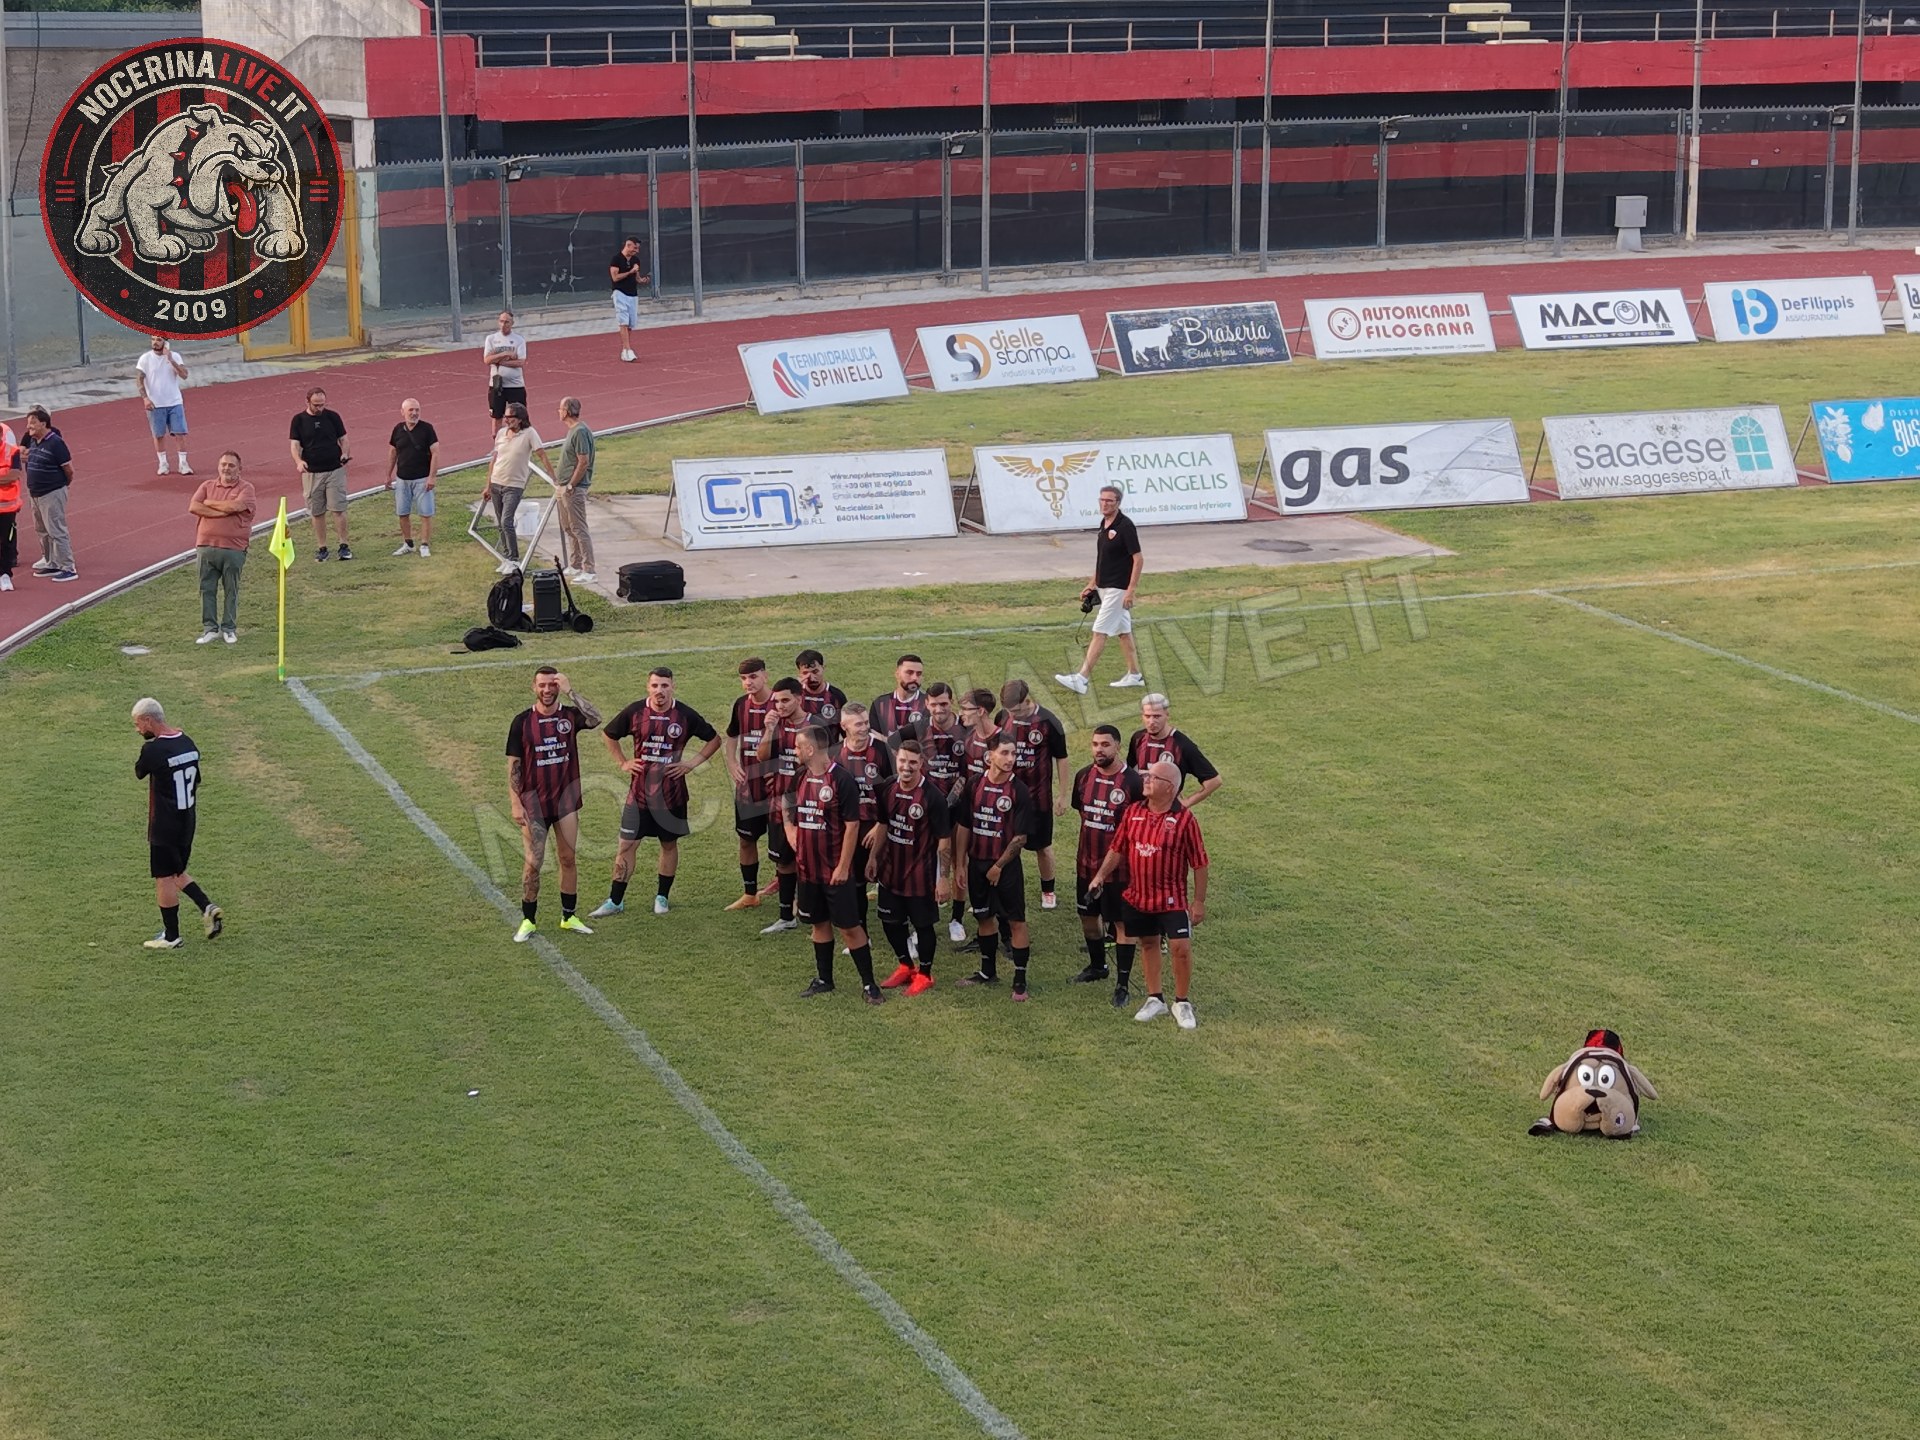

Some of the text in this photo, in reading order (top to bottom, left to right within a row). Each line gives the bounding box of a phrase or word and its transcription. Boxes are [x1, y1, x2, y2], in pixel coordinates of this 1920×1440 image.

[1362, 303, 1470, 321] AUTORICAMBI
[1540, 299, 1671, 328] MACOM
[1781, 296, 1854, 313] DeFilippis
[1365, 321, 1474, 340] FILOGRANA
[790, 346, 877, 369] TERMOIDRAULICA
[811, 363, 883, 387] SPINIELLO
[1106, 450, 1212, 472] FARMACIA
[1111, 472, 1228, 495] DE ANGELIS
[1280, 444, 1411, 507] gas
[1579, 467, 1731, 488] www.saggesespa.it
[173, 765, 197, 810] 12
